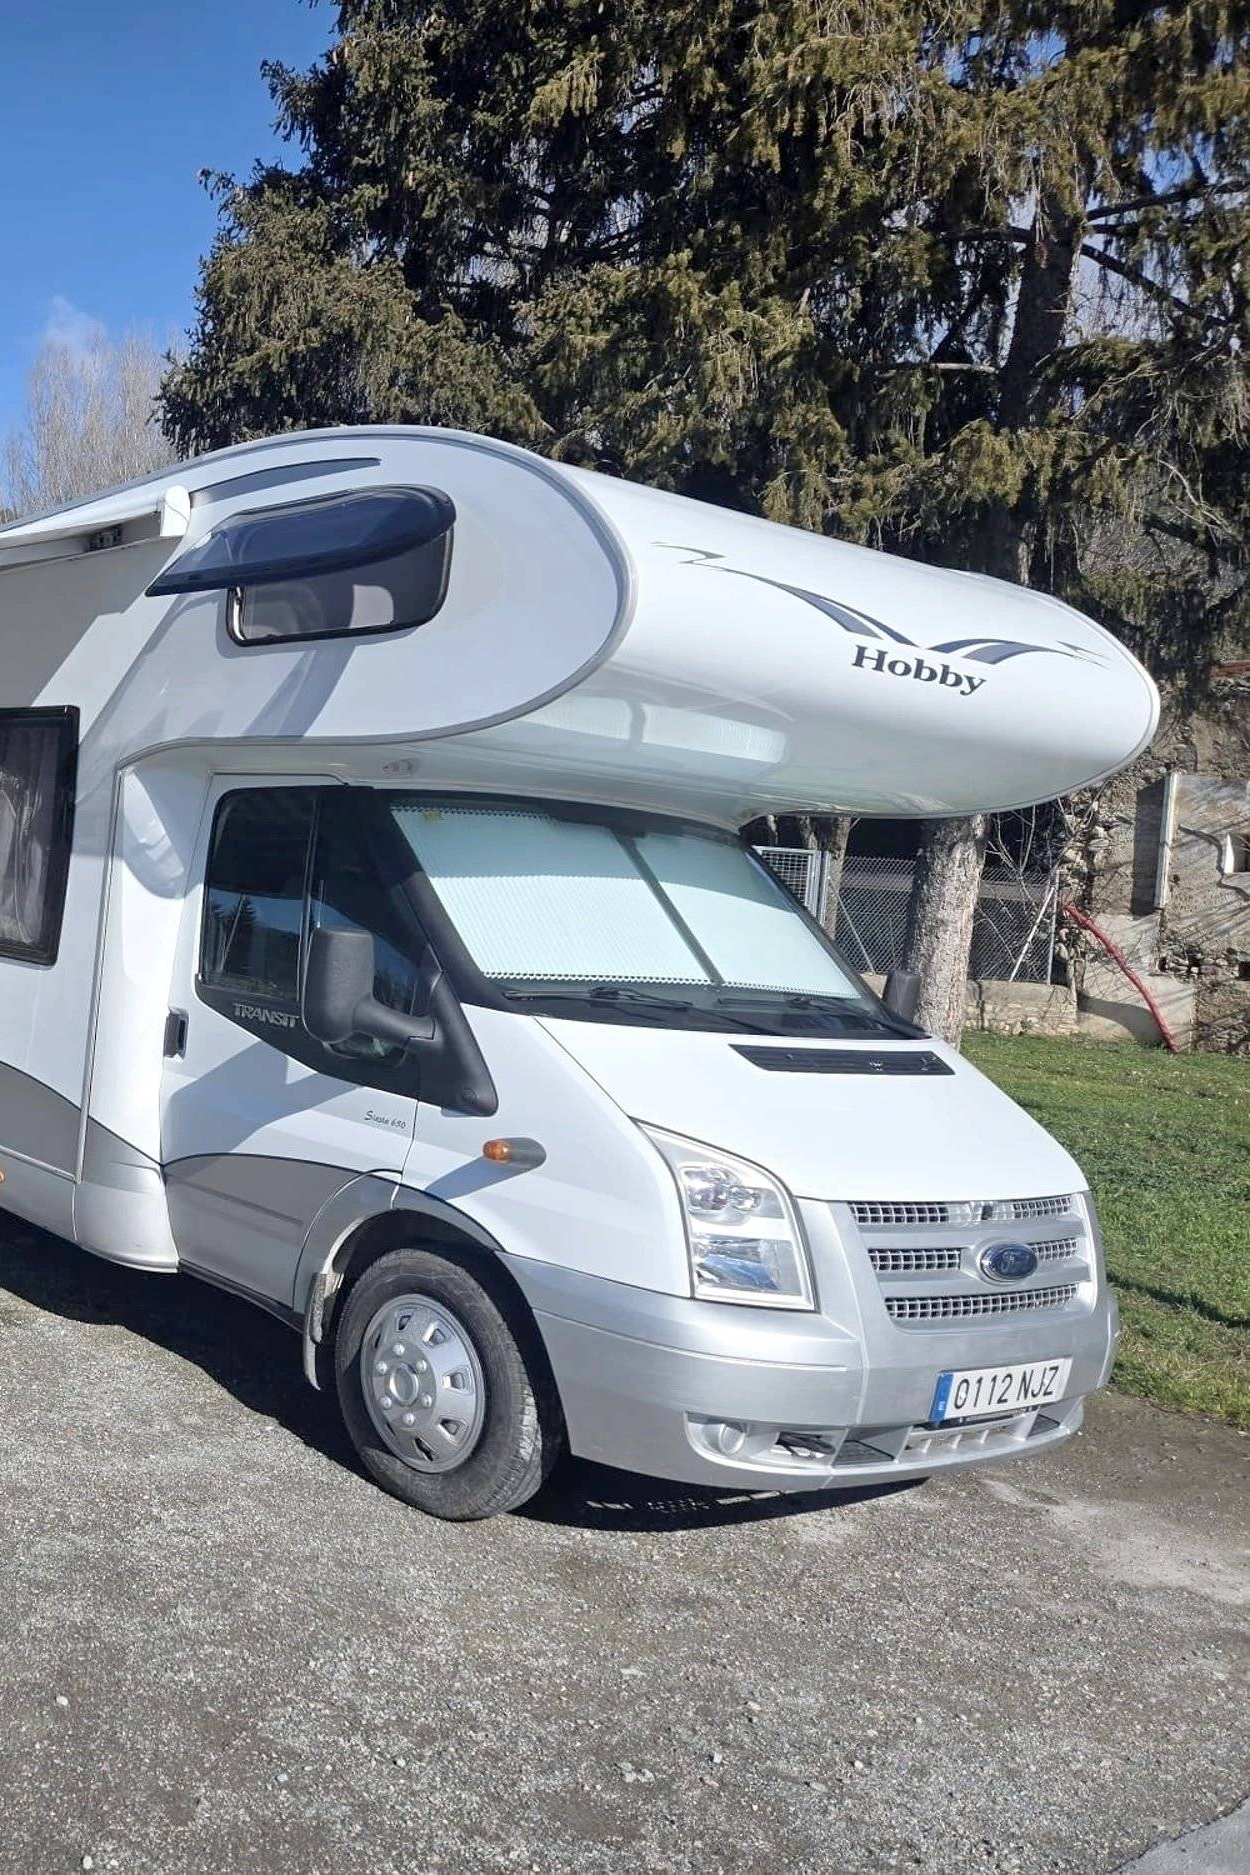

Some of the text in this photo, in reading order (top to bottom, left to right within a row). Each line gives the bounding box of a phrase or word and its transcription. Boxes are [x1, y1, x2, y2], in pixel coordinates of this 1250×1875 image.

[851, 644, 987, 696] Hobby
[232, 1002, 300, 1028] TRANSIT
[953, 1365, 1060, 1410] 0112 NJZ
